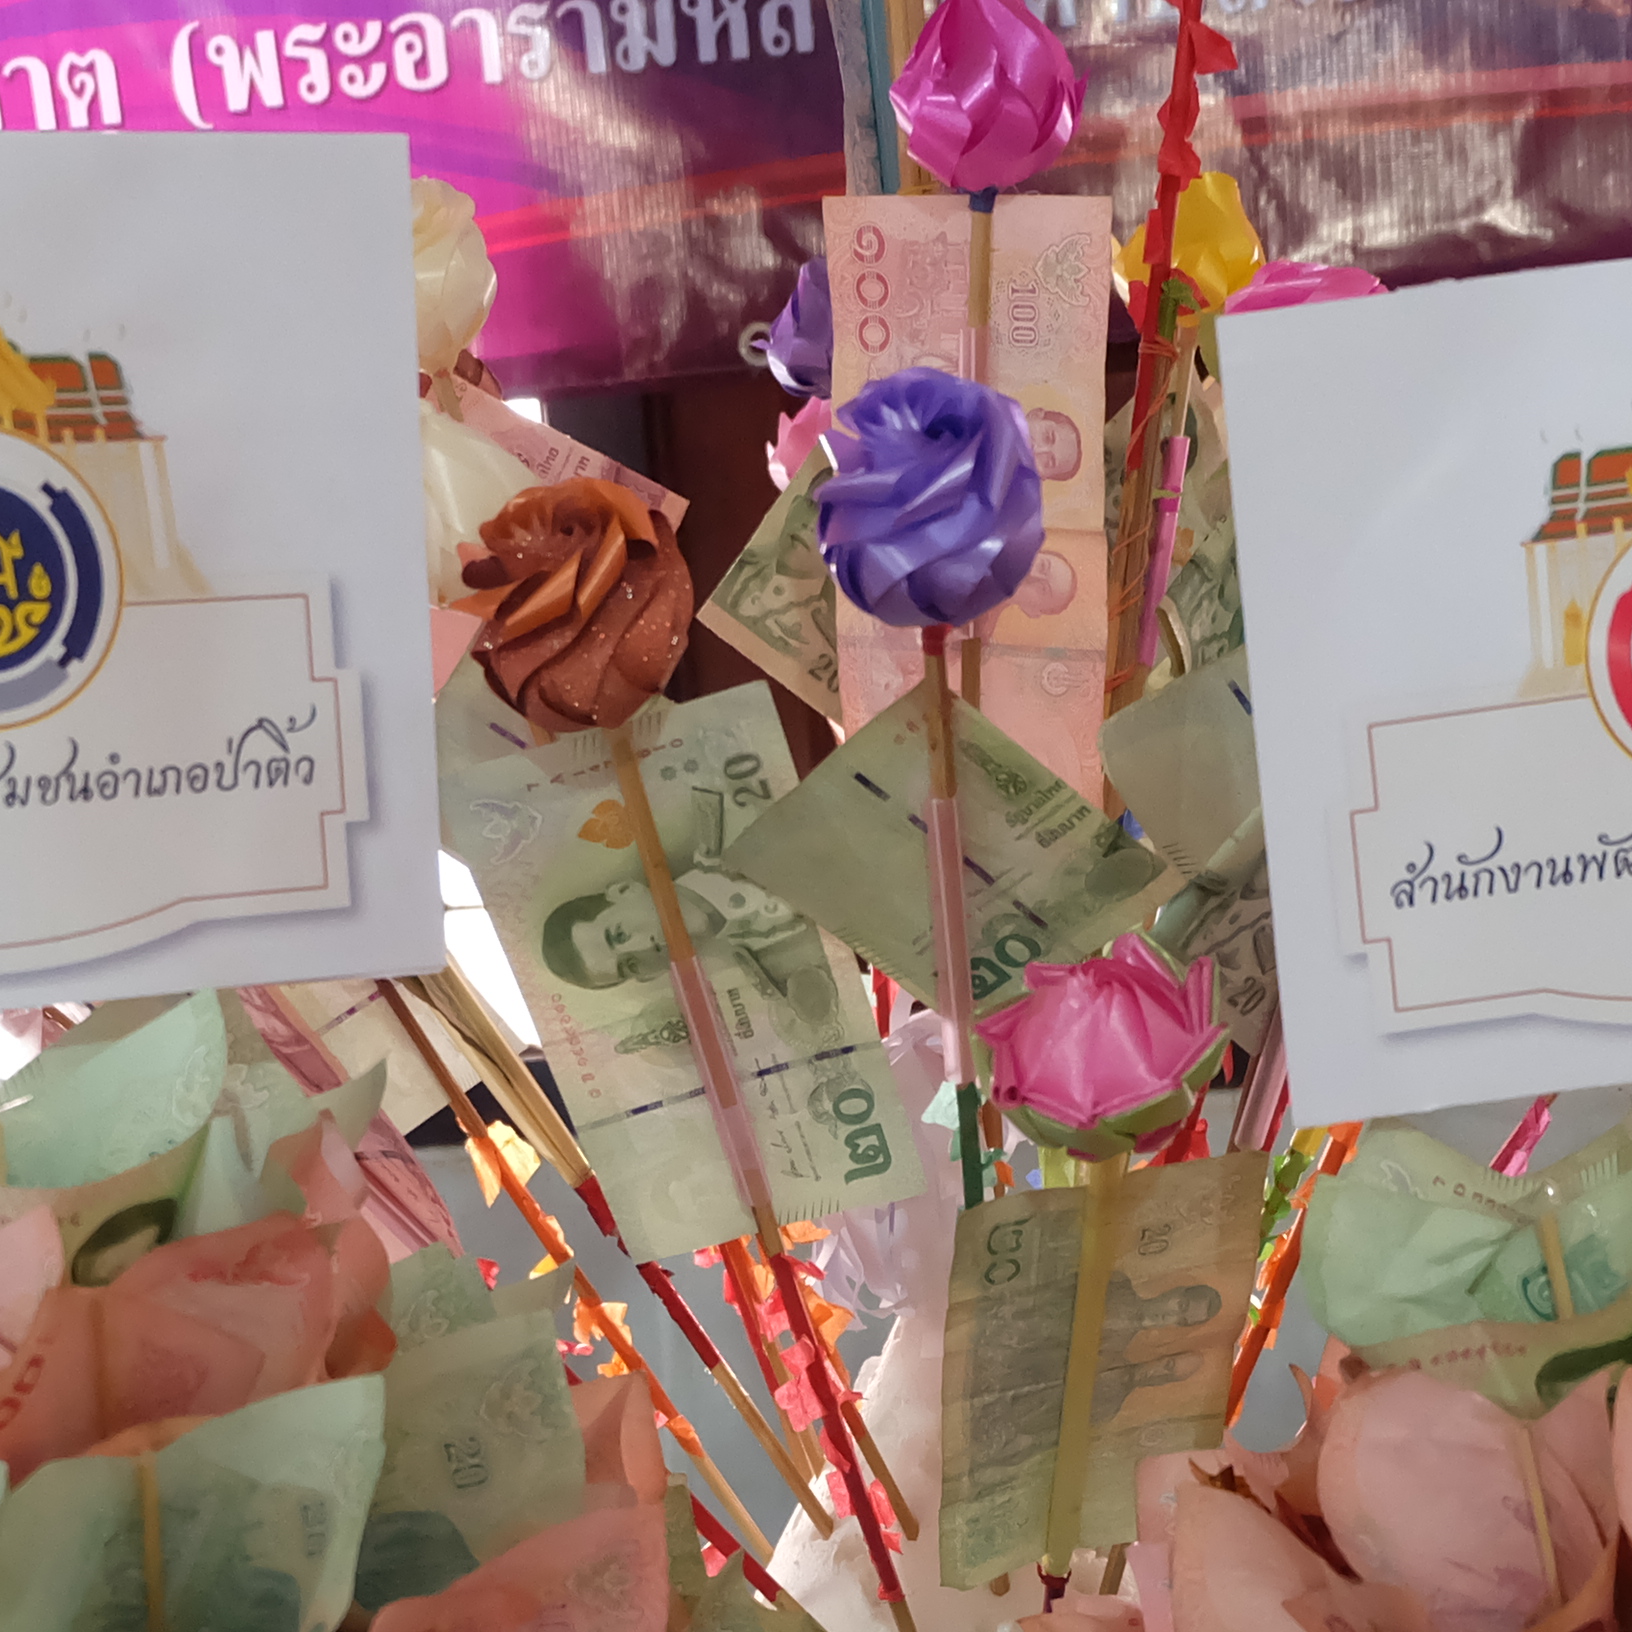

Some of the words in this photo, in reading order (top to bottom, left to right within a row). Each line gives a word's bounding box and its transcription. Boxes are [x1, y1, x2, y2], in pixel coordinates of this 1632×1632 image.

[851, 224, 890, 356] ๑๐๐
[1006, 276, 1037, 351] 100
[721, 750, 770, 811] 20
[833, 1085, 894, 1187] ๒๐
[444, 1433, 490, 1492] 20
